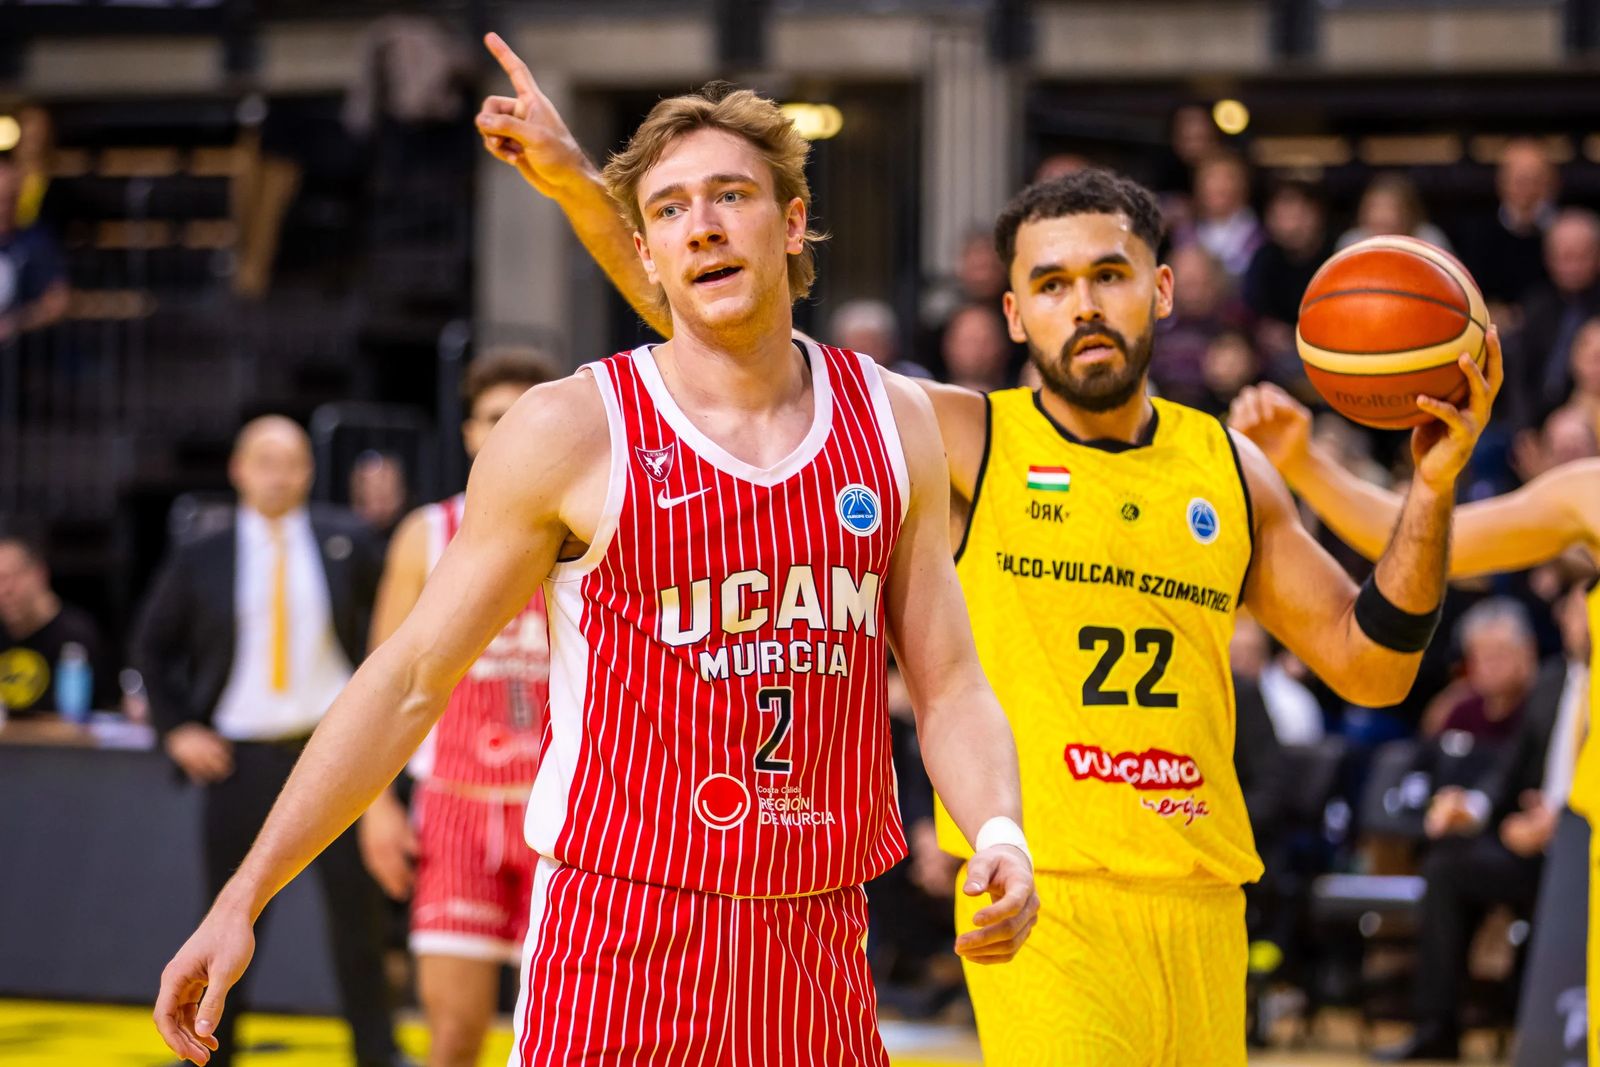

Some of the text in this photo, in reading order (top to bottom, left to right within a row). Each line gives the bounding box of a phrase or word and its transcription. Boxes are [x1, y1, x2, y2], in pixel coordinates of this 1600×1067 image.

[660, 564, 880, 647] UCAM
[698, 639, 849, 684] MURCIA
[1078, 624, 1179, 709] 22
[753, 686, 794, 774] 2
[1069, 748, 1201, 784] VUCANO
[757, 785, 779, 793] Costa
[760, 795, 810, 812] REGIÓN
[761, 811, 836, 826] DE MURCIA
